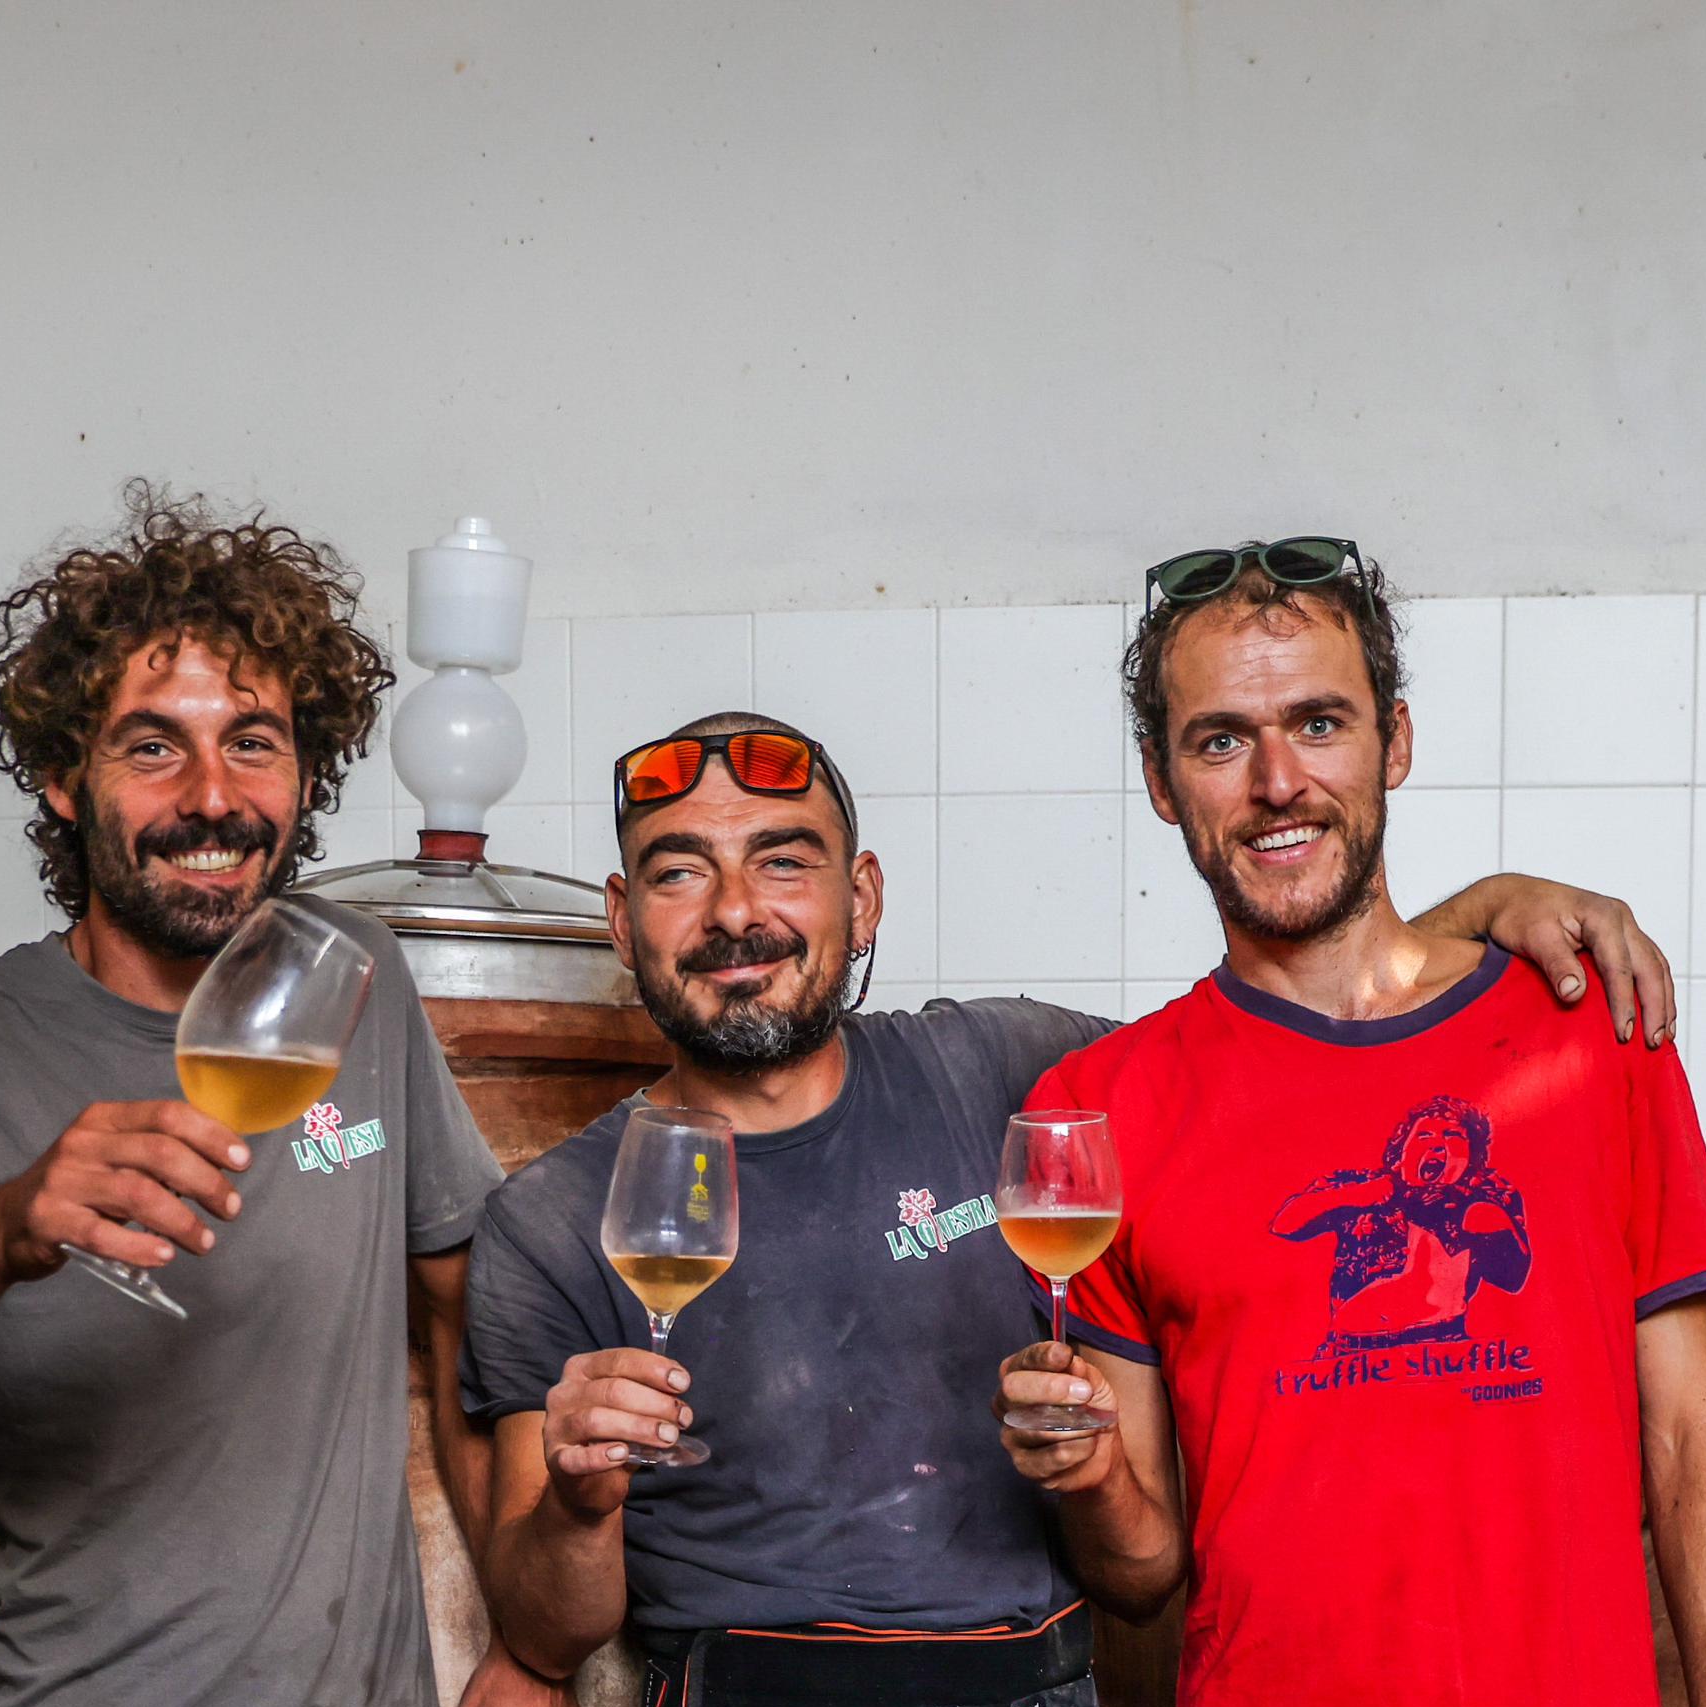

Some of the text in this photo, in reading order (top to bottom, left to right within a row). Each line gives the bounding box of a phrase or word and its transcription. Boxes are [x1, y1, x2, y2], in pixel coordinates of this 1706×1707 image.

[291, 1138, 334, 1174] LA
[885, 1226, 929, 1261] LA
[1275, 1339, 1533, 1395] truffle shuffle
